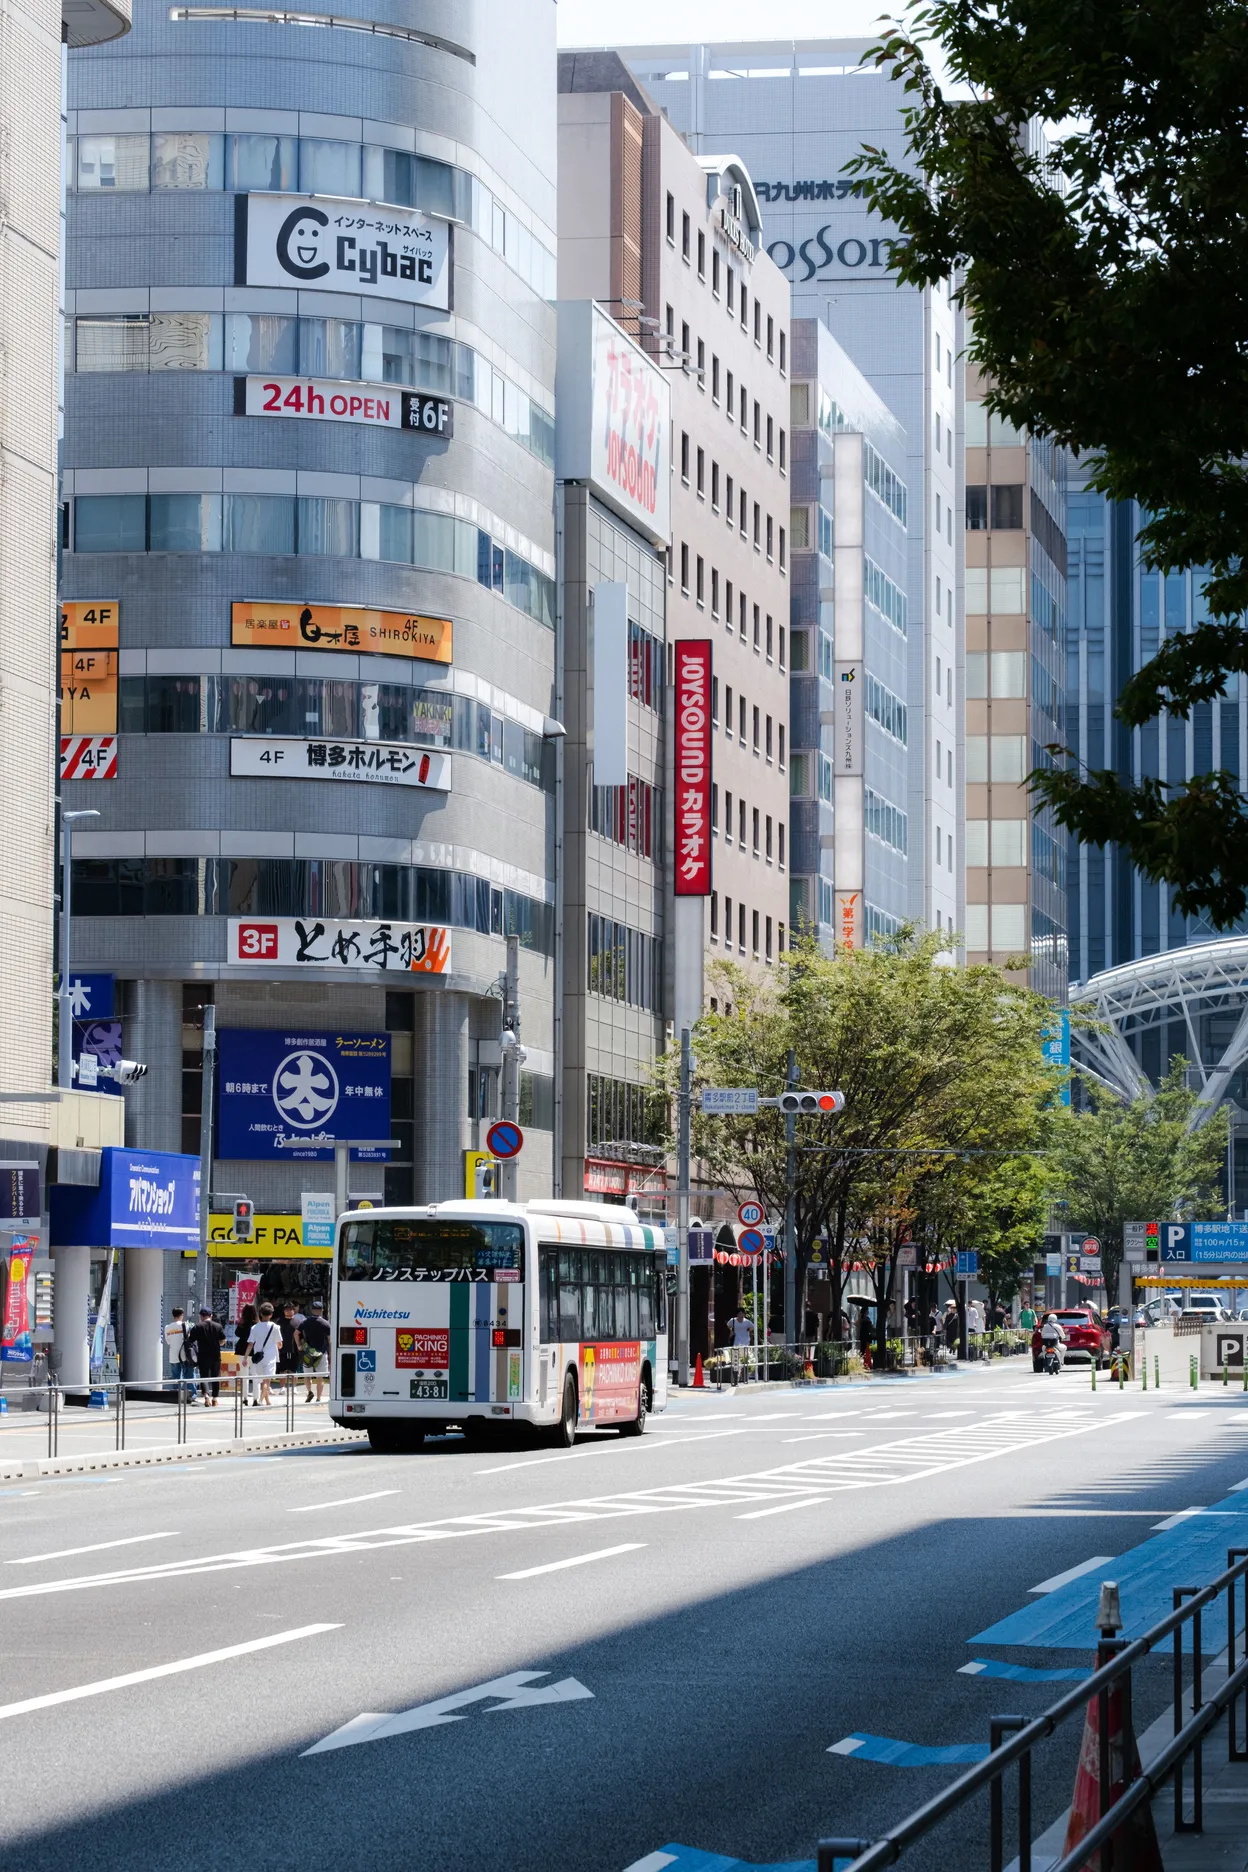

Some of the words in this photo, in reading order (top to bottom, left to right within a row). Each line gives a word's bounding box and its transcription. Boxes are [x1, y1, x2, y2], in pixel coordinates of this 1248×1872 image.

[334, 216, 433, 243] インターネットスペース
[402, 245, 433, 259] サイバック
[336, 235, 433, 285] Cybac
[262, 383, 325, 415] 24h
[329, 394, 390, 422] OPEN
[409, 397, 420, 427] 受付
[422, 400, 448, 431] 6F
[607, 428, 656, 515] JOYSOUND
[83, 609, 111, 624] 4F
[404, 618, 418, 632] 4F
[369, 626, 436, 646] SHIROKIYA
[75, 658, 95, 672] 4F
[681, 653, 705, 784] JOYSOUND
[81, 749, 107, 767] 4F
[259, 750, 285, 764] 4F
[307, 743, 416, 773] 博多ホルモン
[680, 788, 705, 881] カラオケ
[242, 929, 275, 954] 3F
[295, 920, 427, 969] とめ手羽
[284, 1037, 327, 1047] 博多創作居酒屋
[335, 1037, 386, 1049] ラーソーメン
[225, 1082, 268, 1094] 朝6時まで
[344, 1085, 383, 1097] 年中無休
[704, 1092, 756, 1103] 博多駅前2丁目
[129, 1176, 176, 1214] アパマンショップ
[307, 1200, 331, 1209] Alpen
[744, 1208, 758, 1220] 40
[307, 1224, 331, 1233] Alpen
[1146, 1223, 1158, 1235] 満
[1168, 1226, 1185, 1247] P
[1166, 1250, 1185, 1259] 入口
[372, 1267, 488, 1281] ノンステップバス
[1132, 1264, 1158, 1273] 博多駅
[354, 1308, 411, 1320] Nishitetsu
[415, 1340, 448, 1352] KING
[1221, 1339, 1240, 1362] P
[365, 1374, 374, 1383] 60
[416, 1385, 446, 1398] 43-81
